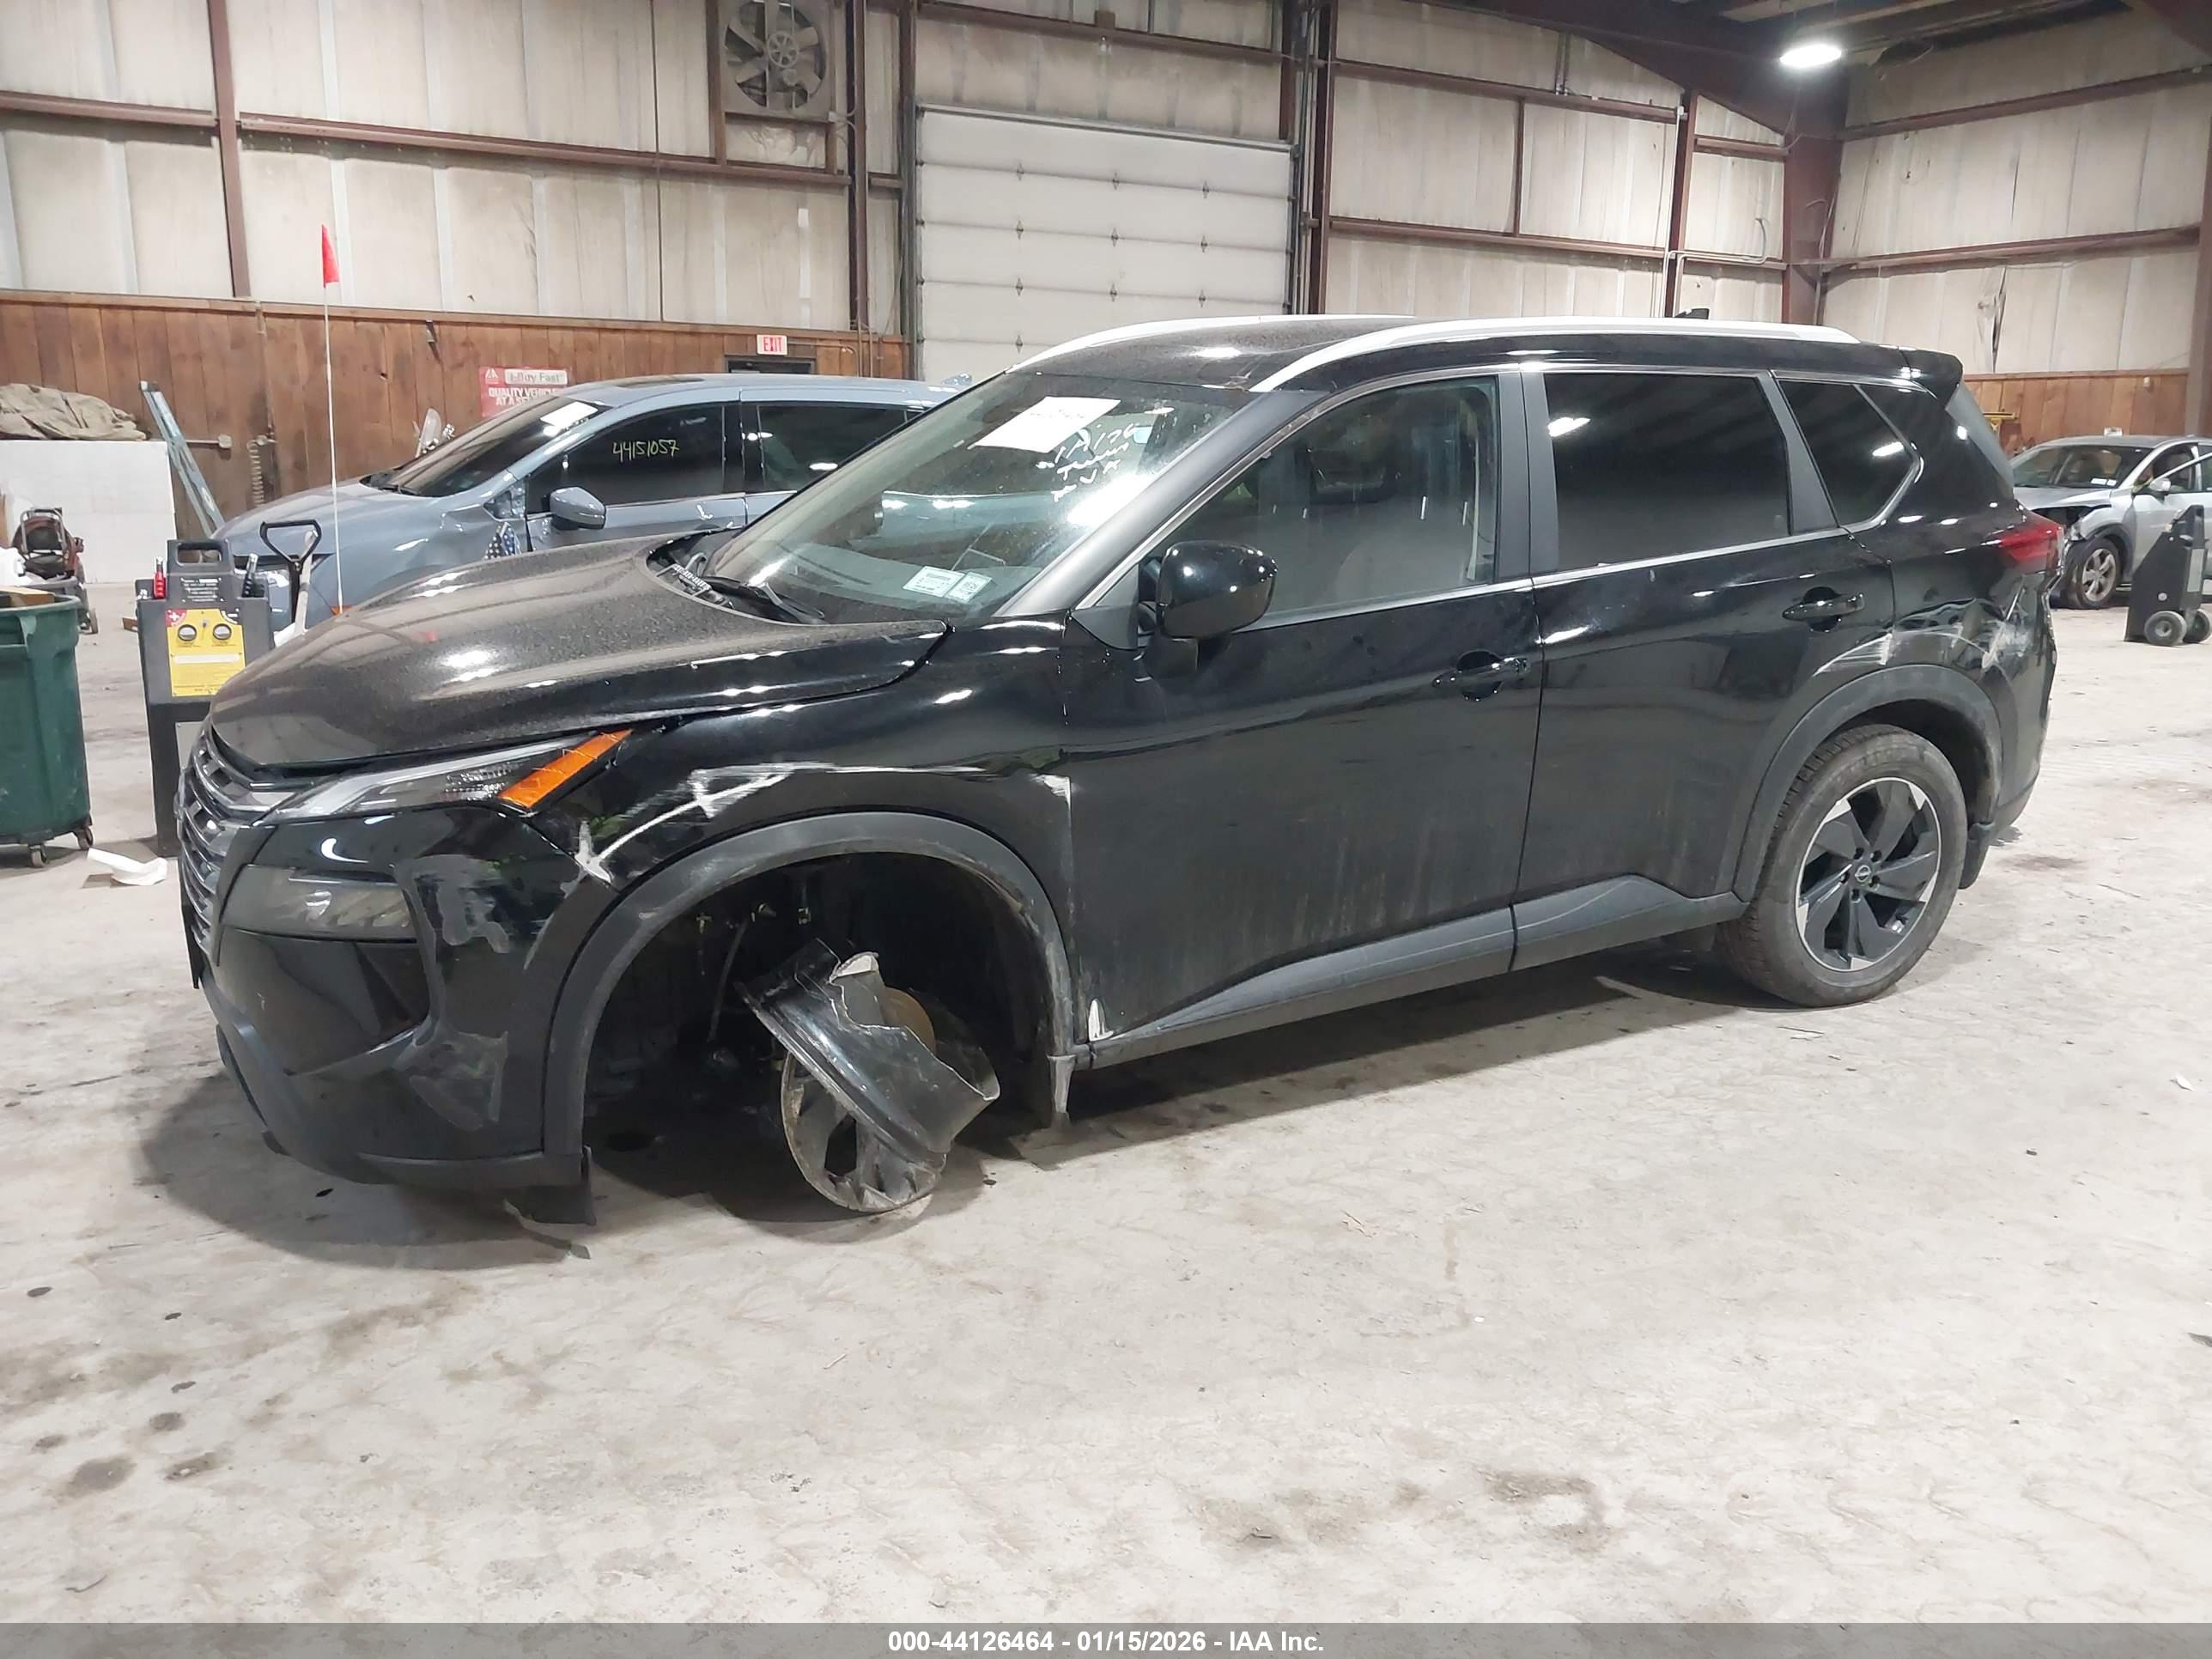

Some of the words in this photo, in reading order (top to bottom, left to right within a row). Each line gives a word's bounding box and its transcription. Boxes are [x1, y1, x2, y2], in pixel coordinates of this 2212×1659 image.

[763, 336, 782, 352] EXIT
[488, 386, 523, 398] QUALITY
[612, 439, 680, 463] 44151057
